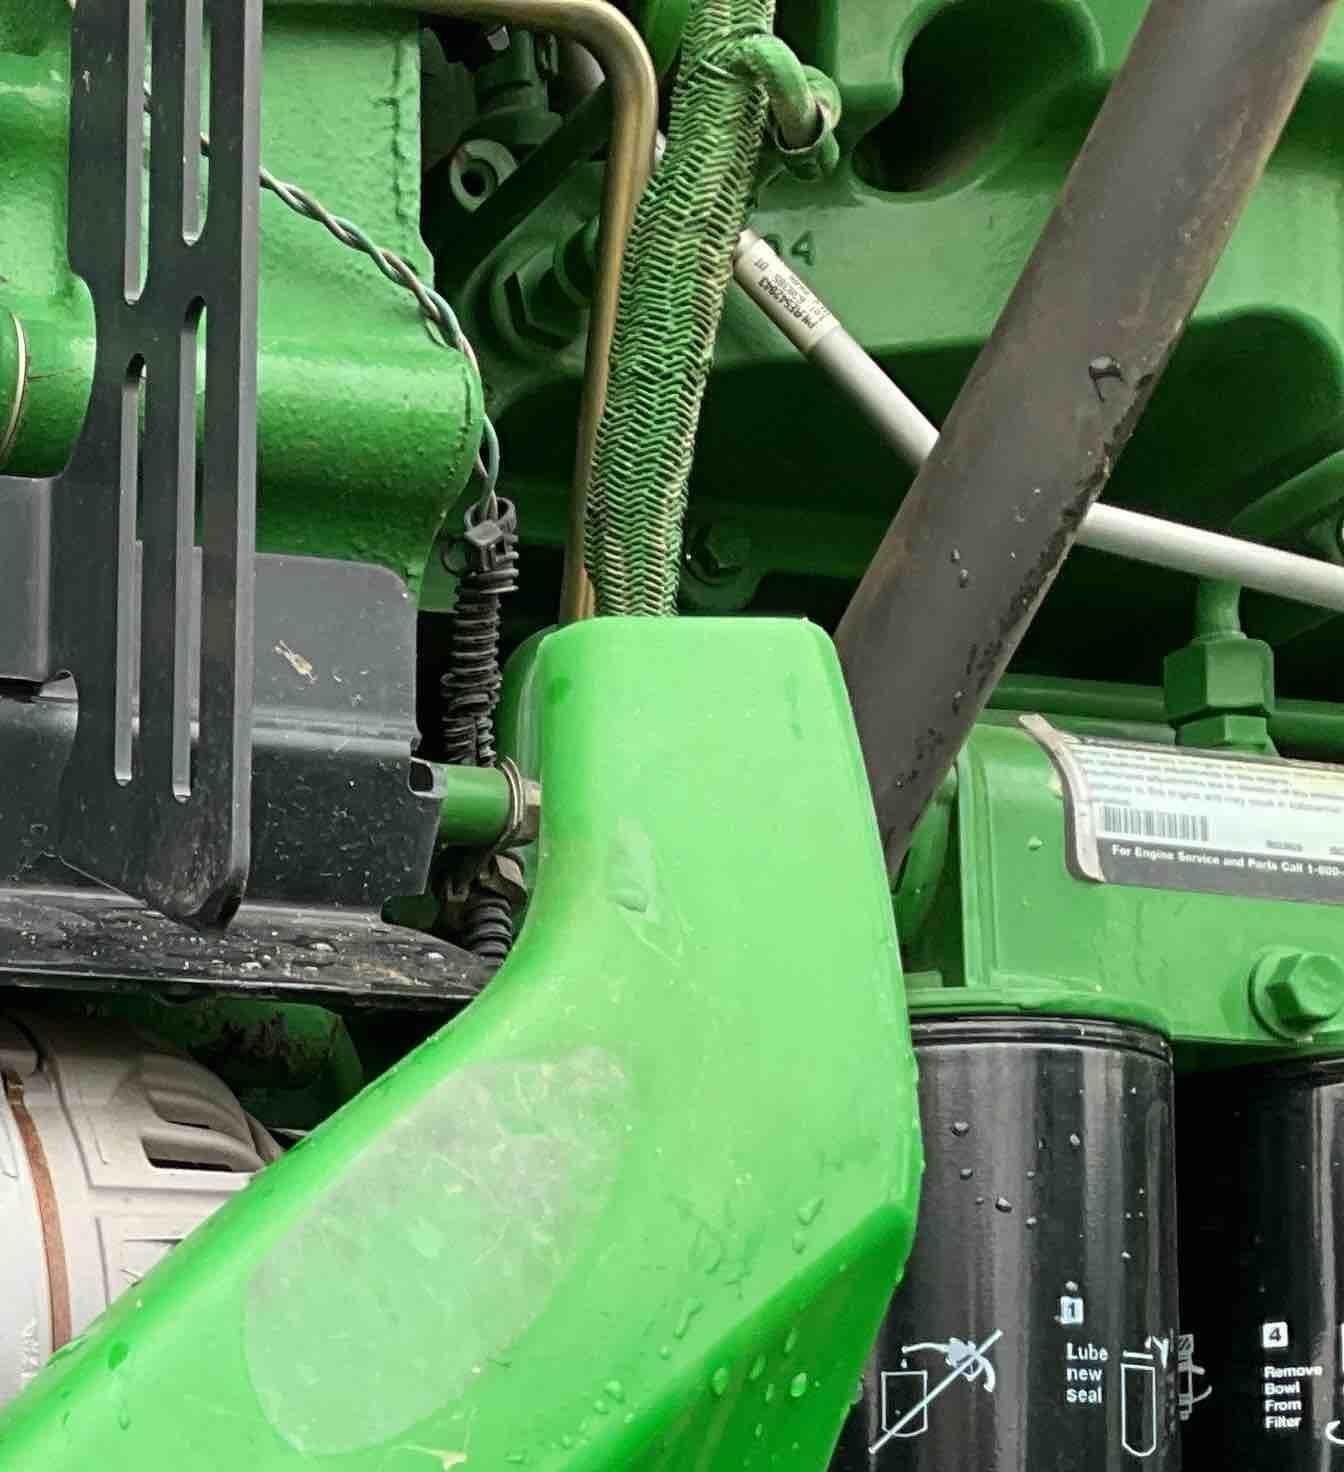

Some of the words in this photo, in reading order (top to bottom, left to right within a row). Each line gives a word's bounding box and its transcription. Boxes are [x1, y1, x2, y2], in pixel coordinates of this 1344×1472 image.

[1112, 844, 1130, 857] For
[1135, 846, 1174, 862] Engine
[1178, 851, 1220, 866] Service
[1224, 855, 1244, 868] and
[1248, 857, 1278, 871] Parts
[1281, 861, 1303, 873] Call
[1066, 1342, 1108, 1361] Lube
[1066, 1367, 1102, 1382] new
[1264, 1365, 1323, 1378] Remove
[1066, 1386, 1103, 1404] seal
[1264, 1381, 1300, 1395] Bowl
[1265, 1400, 1302, 1412] From
[1265, 1415, 1302, 1429] Filter
